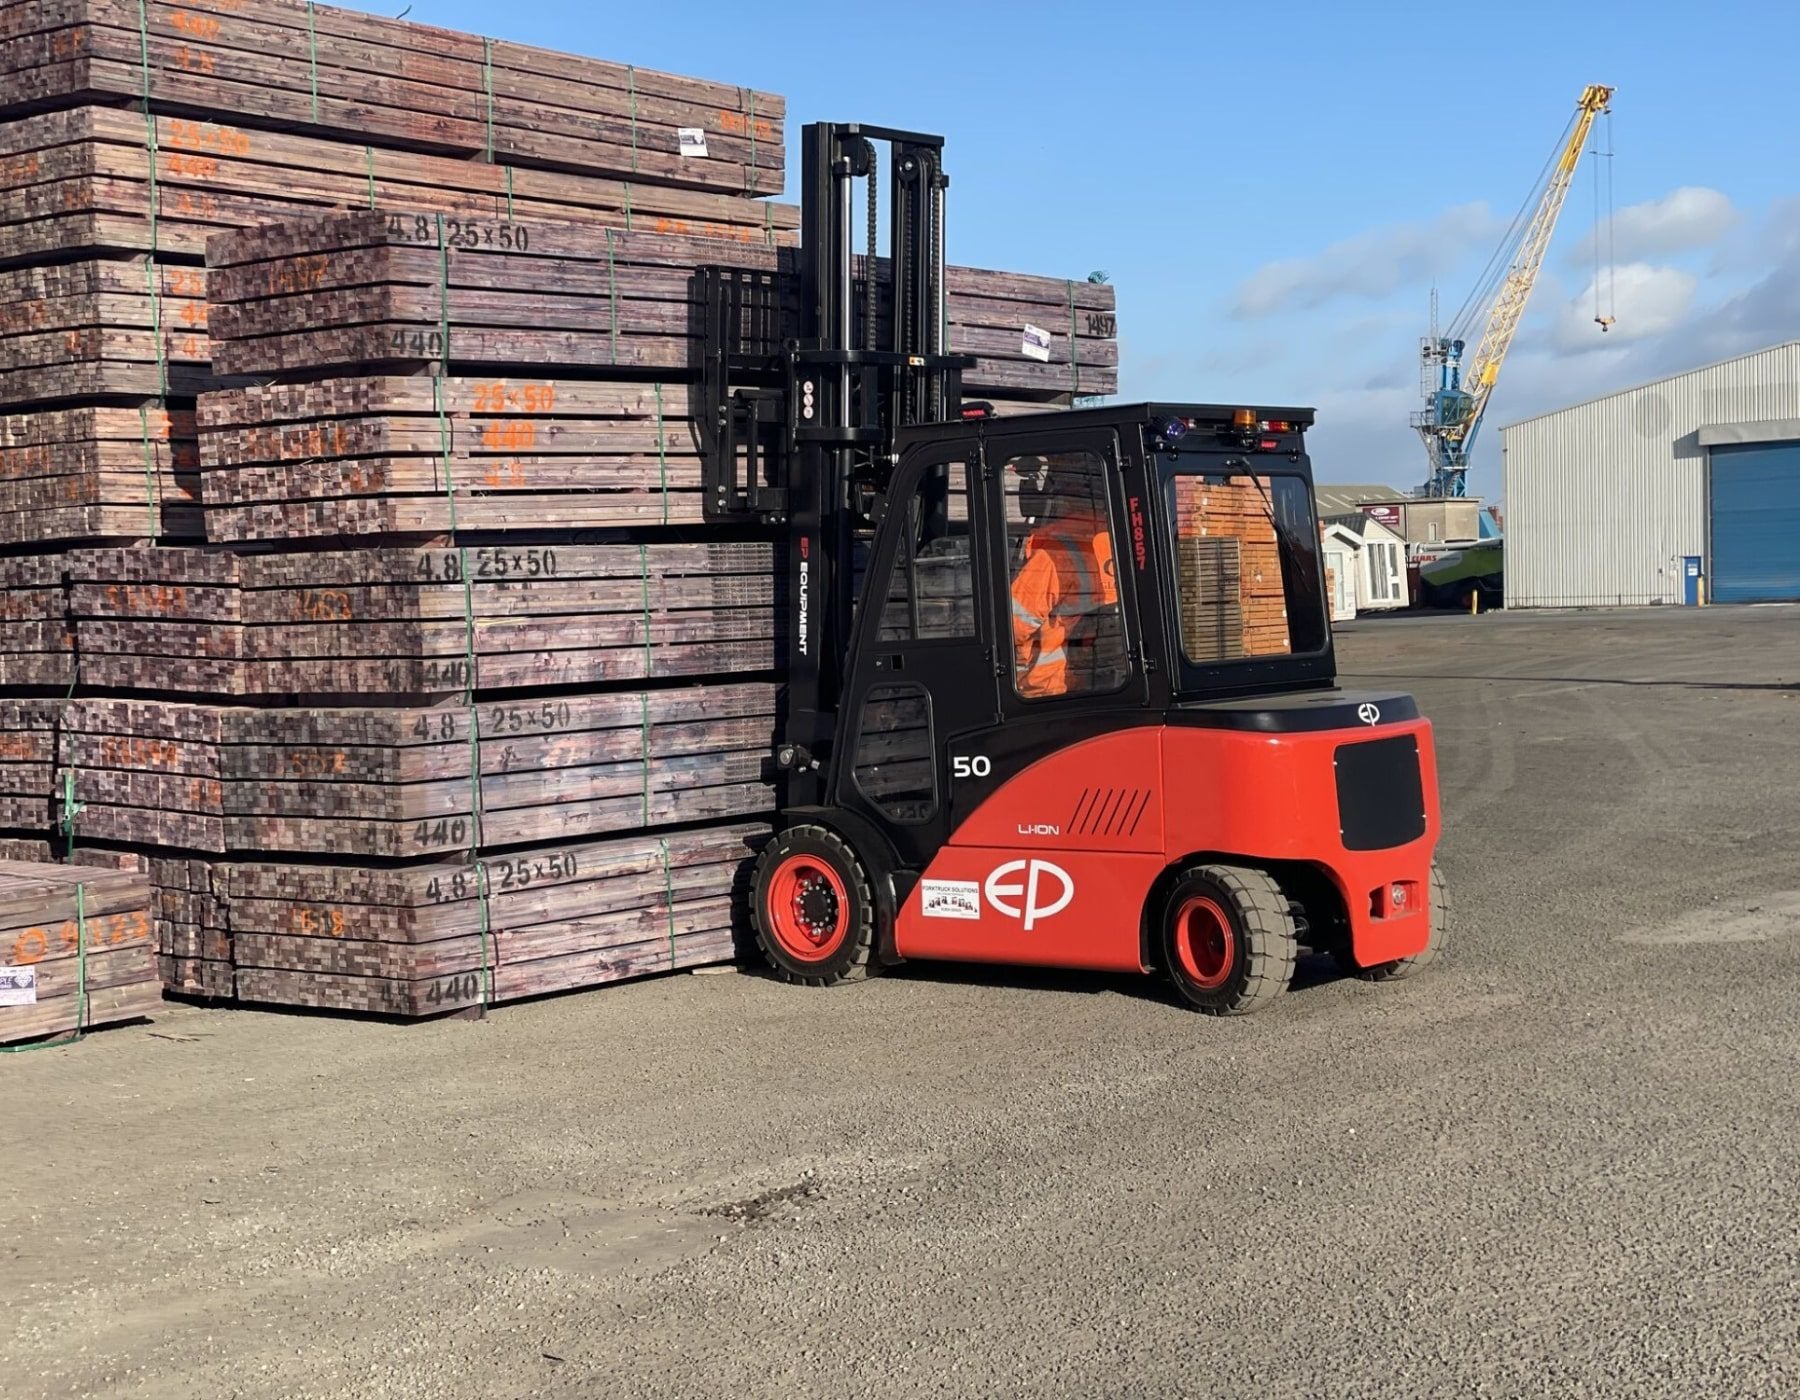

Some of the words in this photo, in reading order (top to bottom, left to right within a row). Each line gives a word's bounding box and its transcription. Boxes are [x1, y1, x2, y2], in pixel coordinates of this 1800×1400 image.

[387, 214, 430, 242] 4.8
[390, 329, 444, 357] 440
[482, 420, 536, 449] 440
[800, 537, 809, 559] EP
[1129, 497, 1146, 571] FH857
[417, 552, 459, 580] 4.8
[799, 562, 809, 656] EQUIPMENT
[413, 713, 455, 741] 4.8
[953, 755, 991, 777] 50
[413, 818, 466, 846] 440
[426, 872, 467, 903] 4.8
[426, 974, 478, 1006] 440
